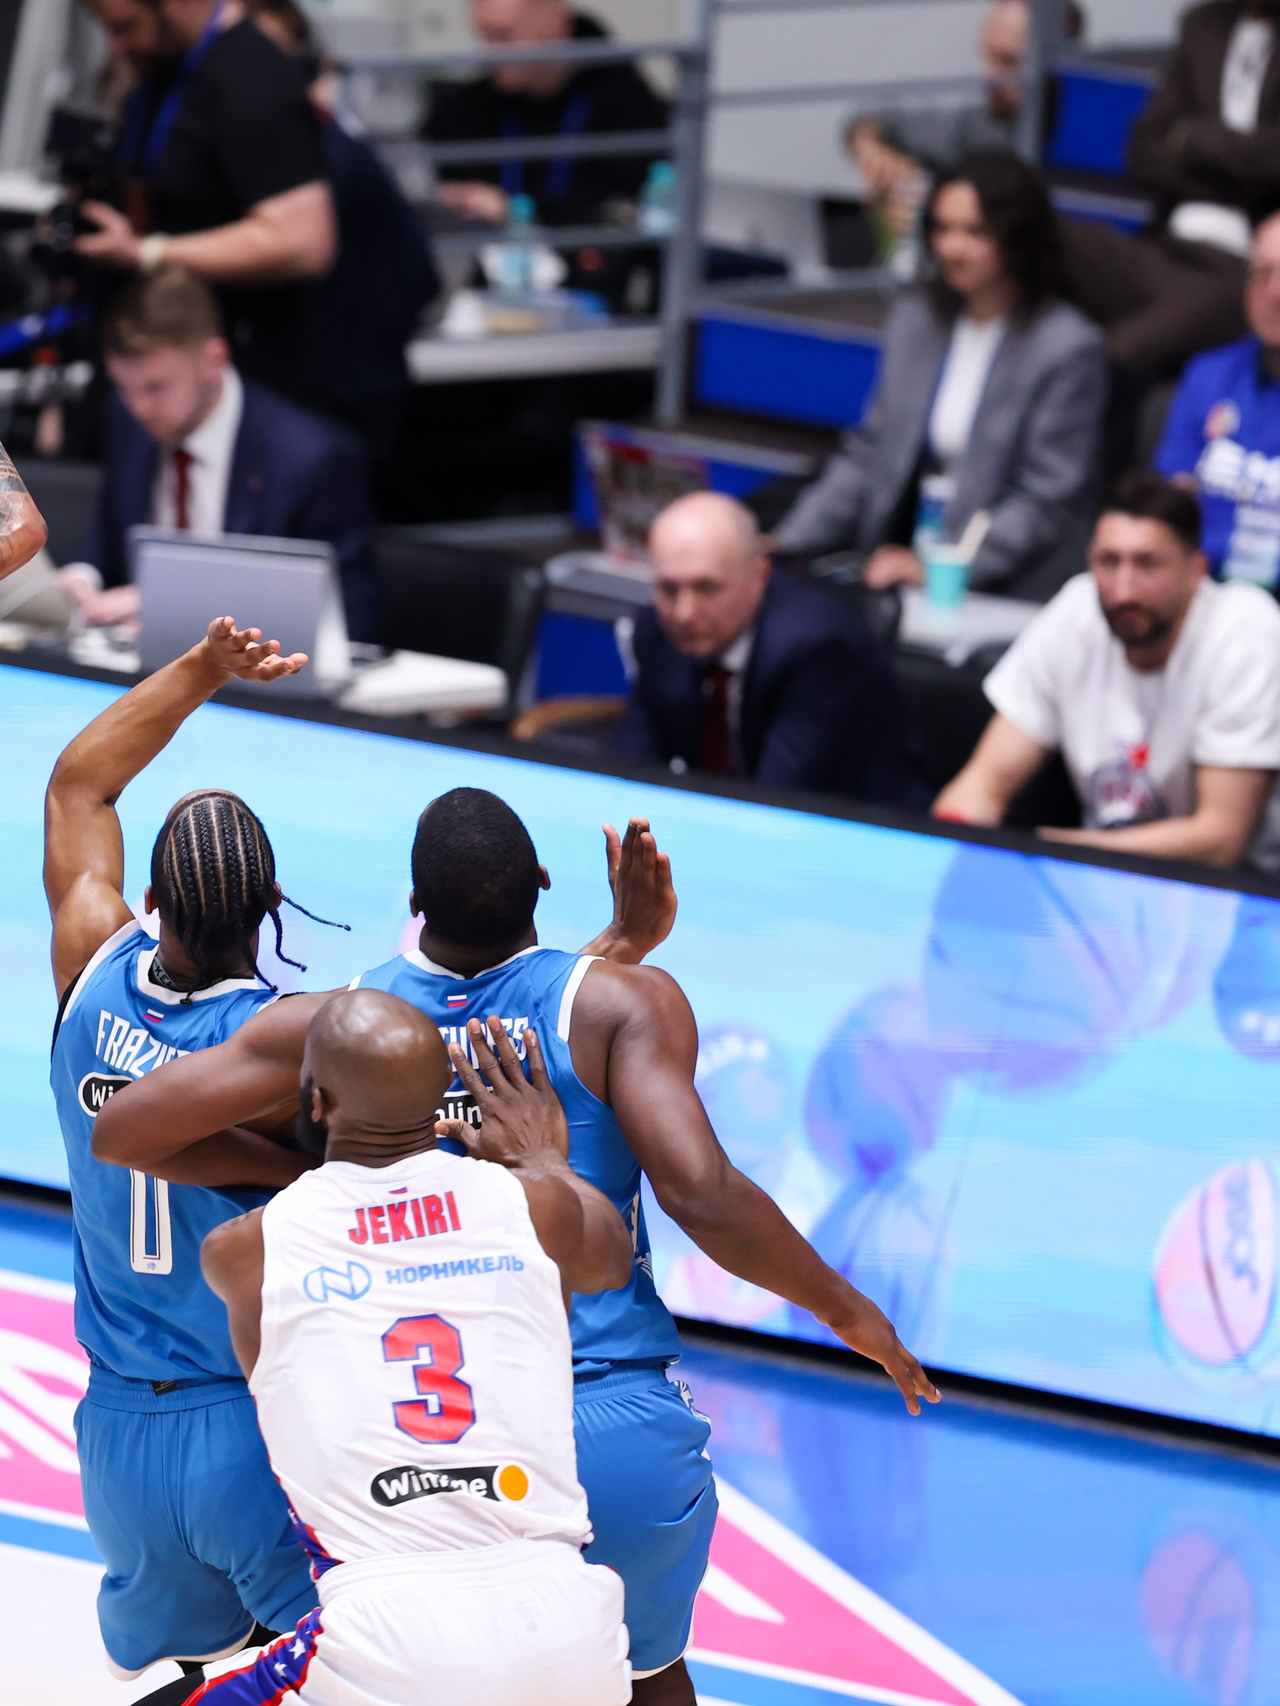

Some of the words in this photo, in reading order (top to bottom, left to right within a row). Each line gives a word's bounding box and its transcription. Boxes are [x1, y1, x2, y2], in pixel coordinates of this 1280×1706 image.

[95, 1009, 193, 1077] FRAZI
[348, 1190, 462, 1246] JEKIRI
[386, 1255, 525, 1285] НОРНИКЕЛЬ
[380, 1313, 476, 1446] 3
